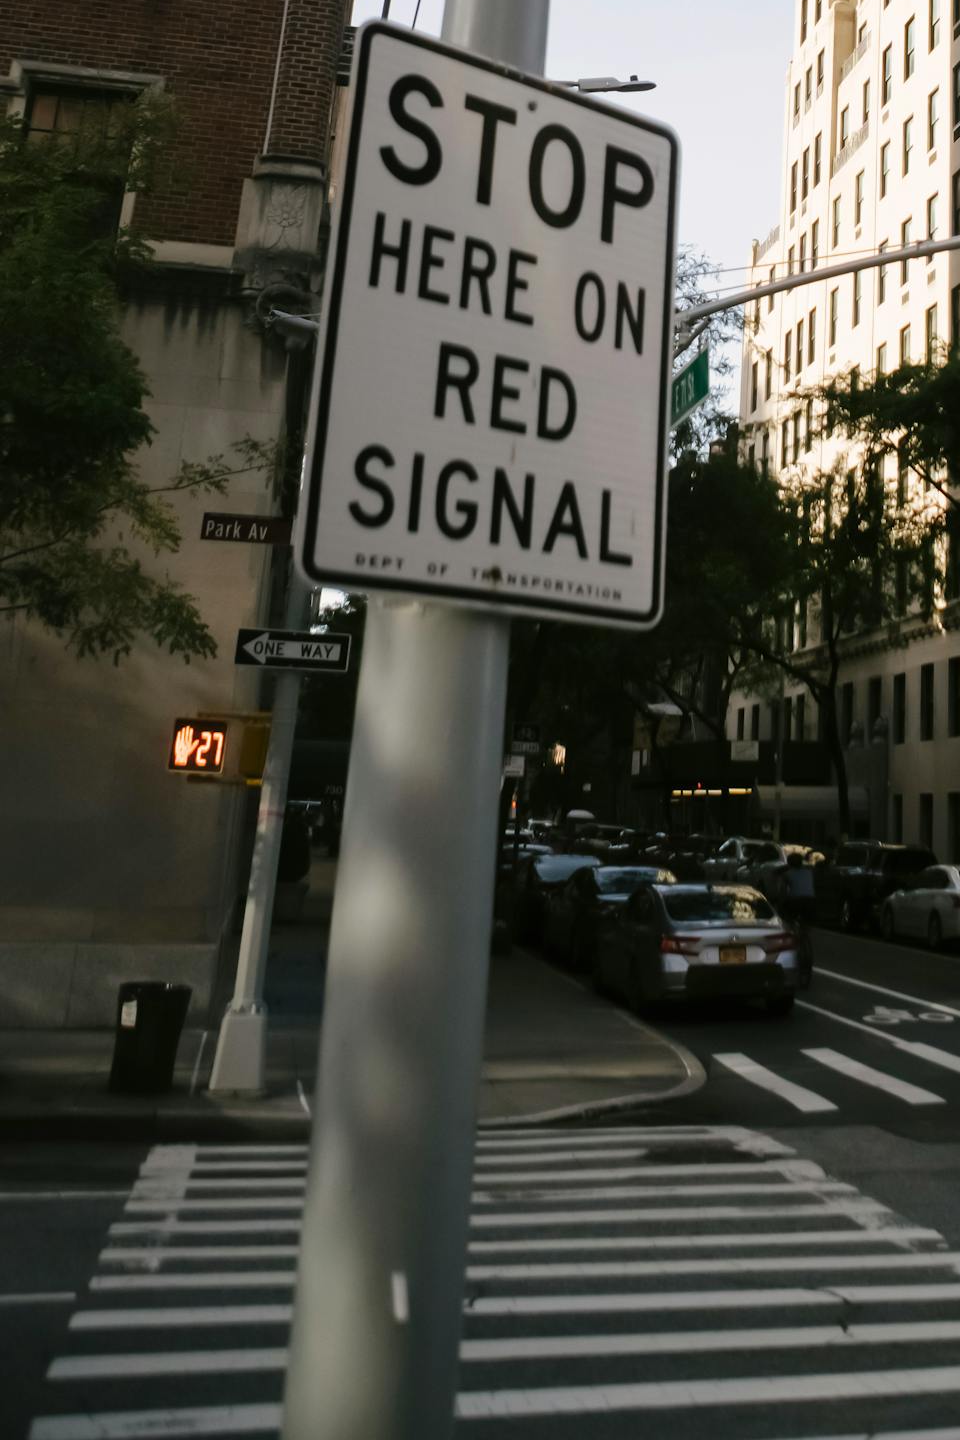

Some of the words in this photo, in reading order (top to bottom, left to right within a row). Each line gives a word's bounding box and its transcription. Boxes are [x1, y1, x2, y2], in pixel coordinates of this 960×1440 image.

[380, 75, 654, 244] STOP
[369, 212, 537, 326] HERE
[575, 271, 646, 355] ON
[434, 341, 577, 442] RED
[205, 520, 242, 539] Park
[248, 522, 268, 541] Av
[349, 445, 633, 567] SIGNAL
[355, 553, 403, 571] DEPT
[426, 562, 448, 577] OF
[253, 640, 286, 657] ONE
[301, 643, 335, 659] WAY
[196, 731, 224, 766] 27
